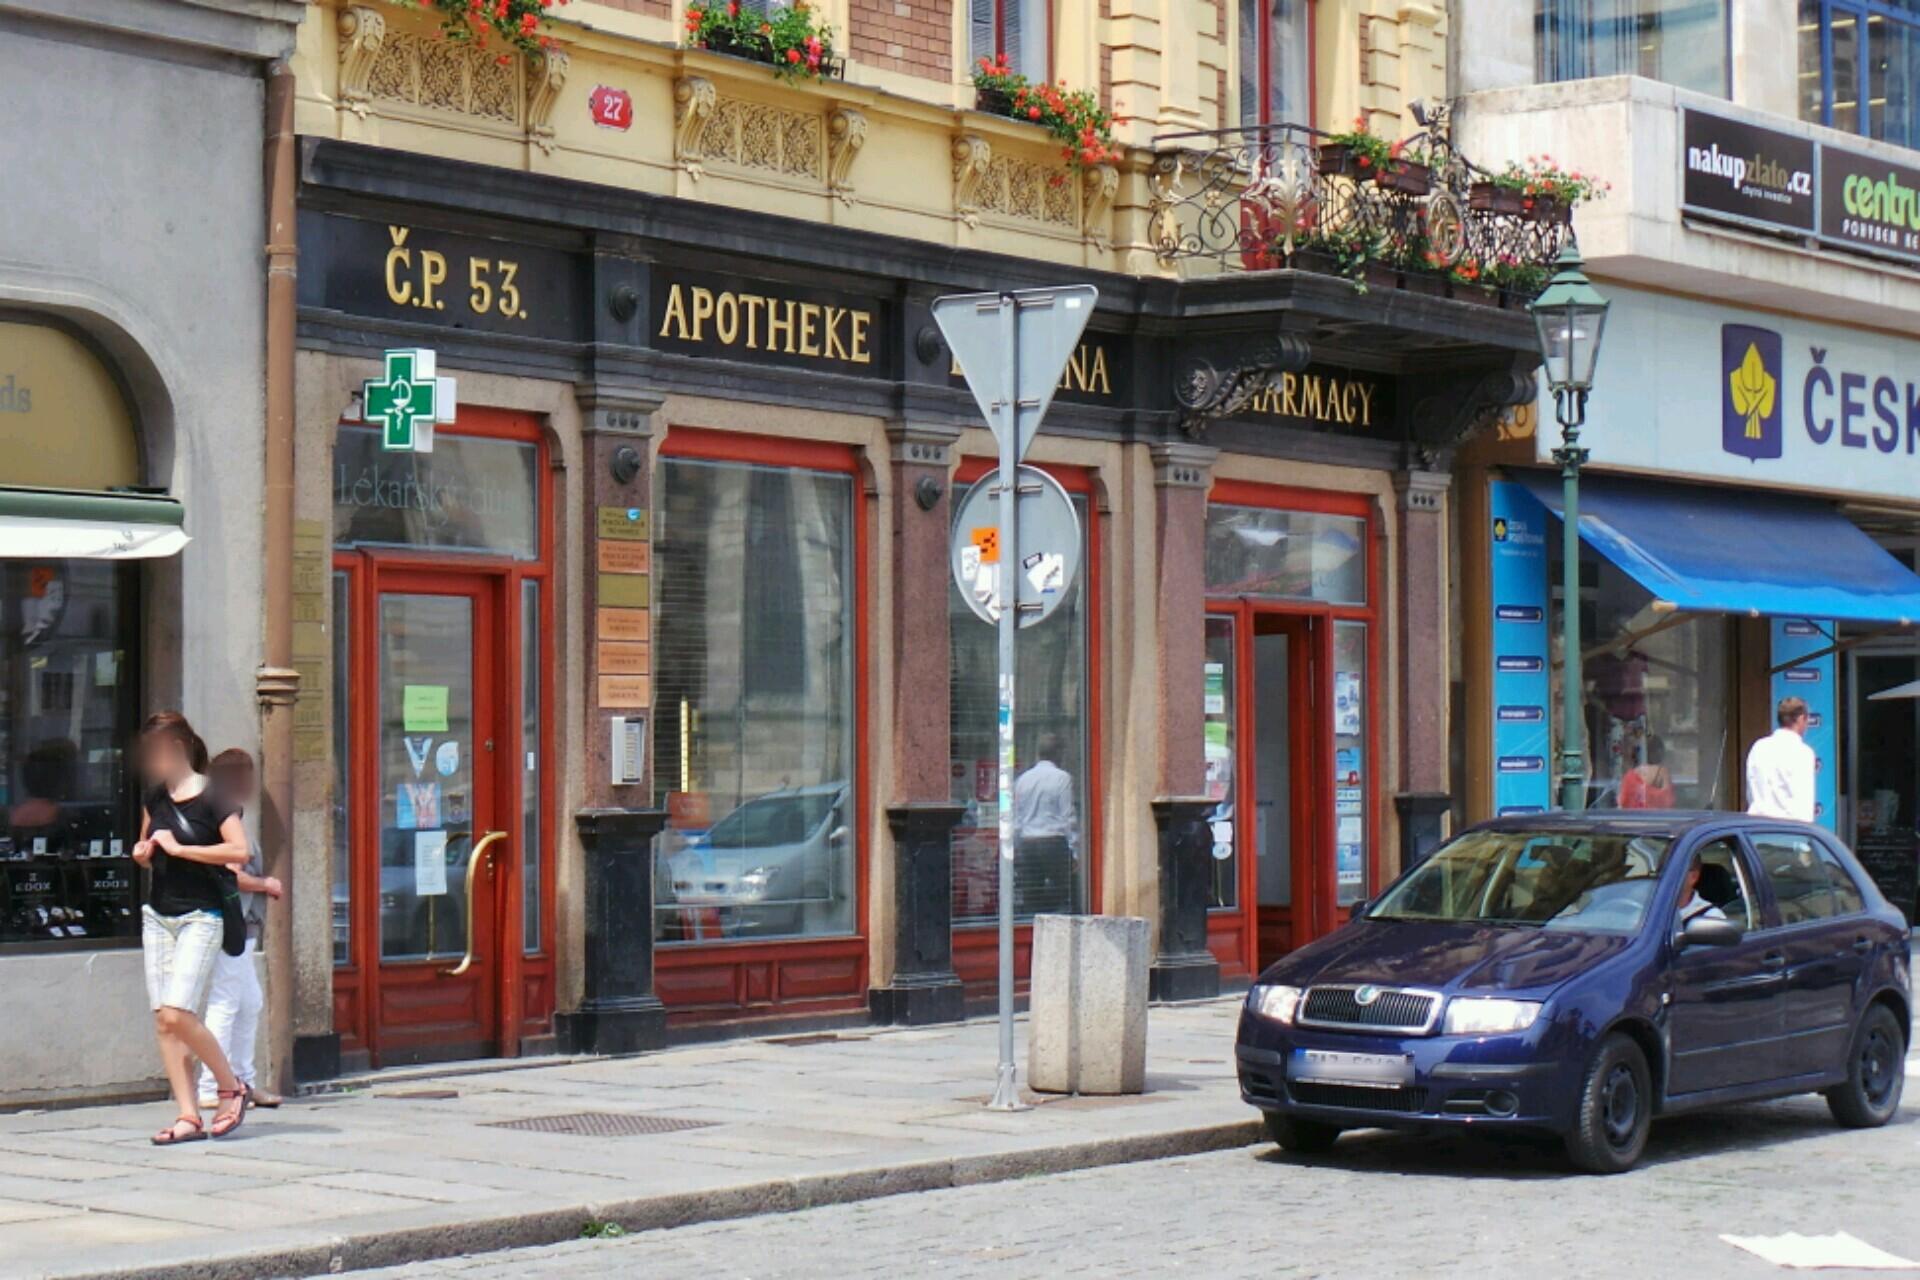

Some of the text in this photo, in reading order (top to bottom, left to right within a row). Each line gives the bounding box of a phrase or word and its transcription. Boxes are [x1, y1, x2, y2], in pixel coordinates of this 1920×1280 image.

[603, 94, 622, 121] 27
[1688, 142, 1812, 196] nakupzlato.cz
[384, 225, 528, 320] Č.P. 53.
[658, 283, 872, 364] APOTHEKE
[1252, 370, 1377, 426] ARMACY
